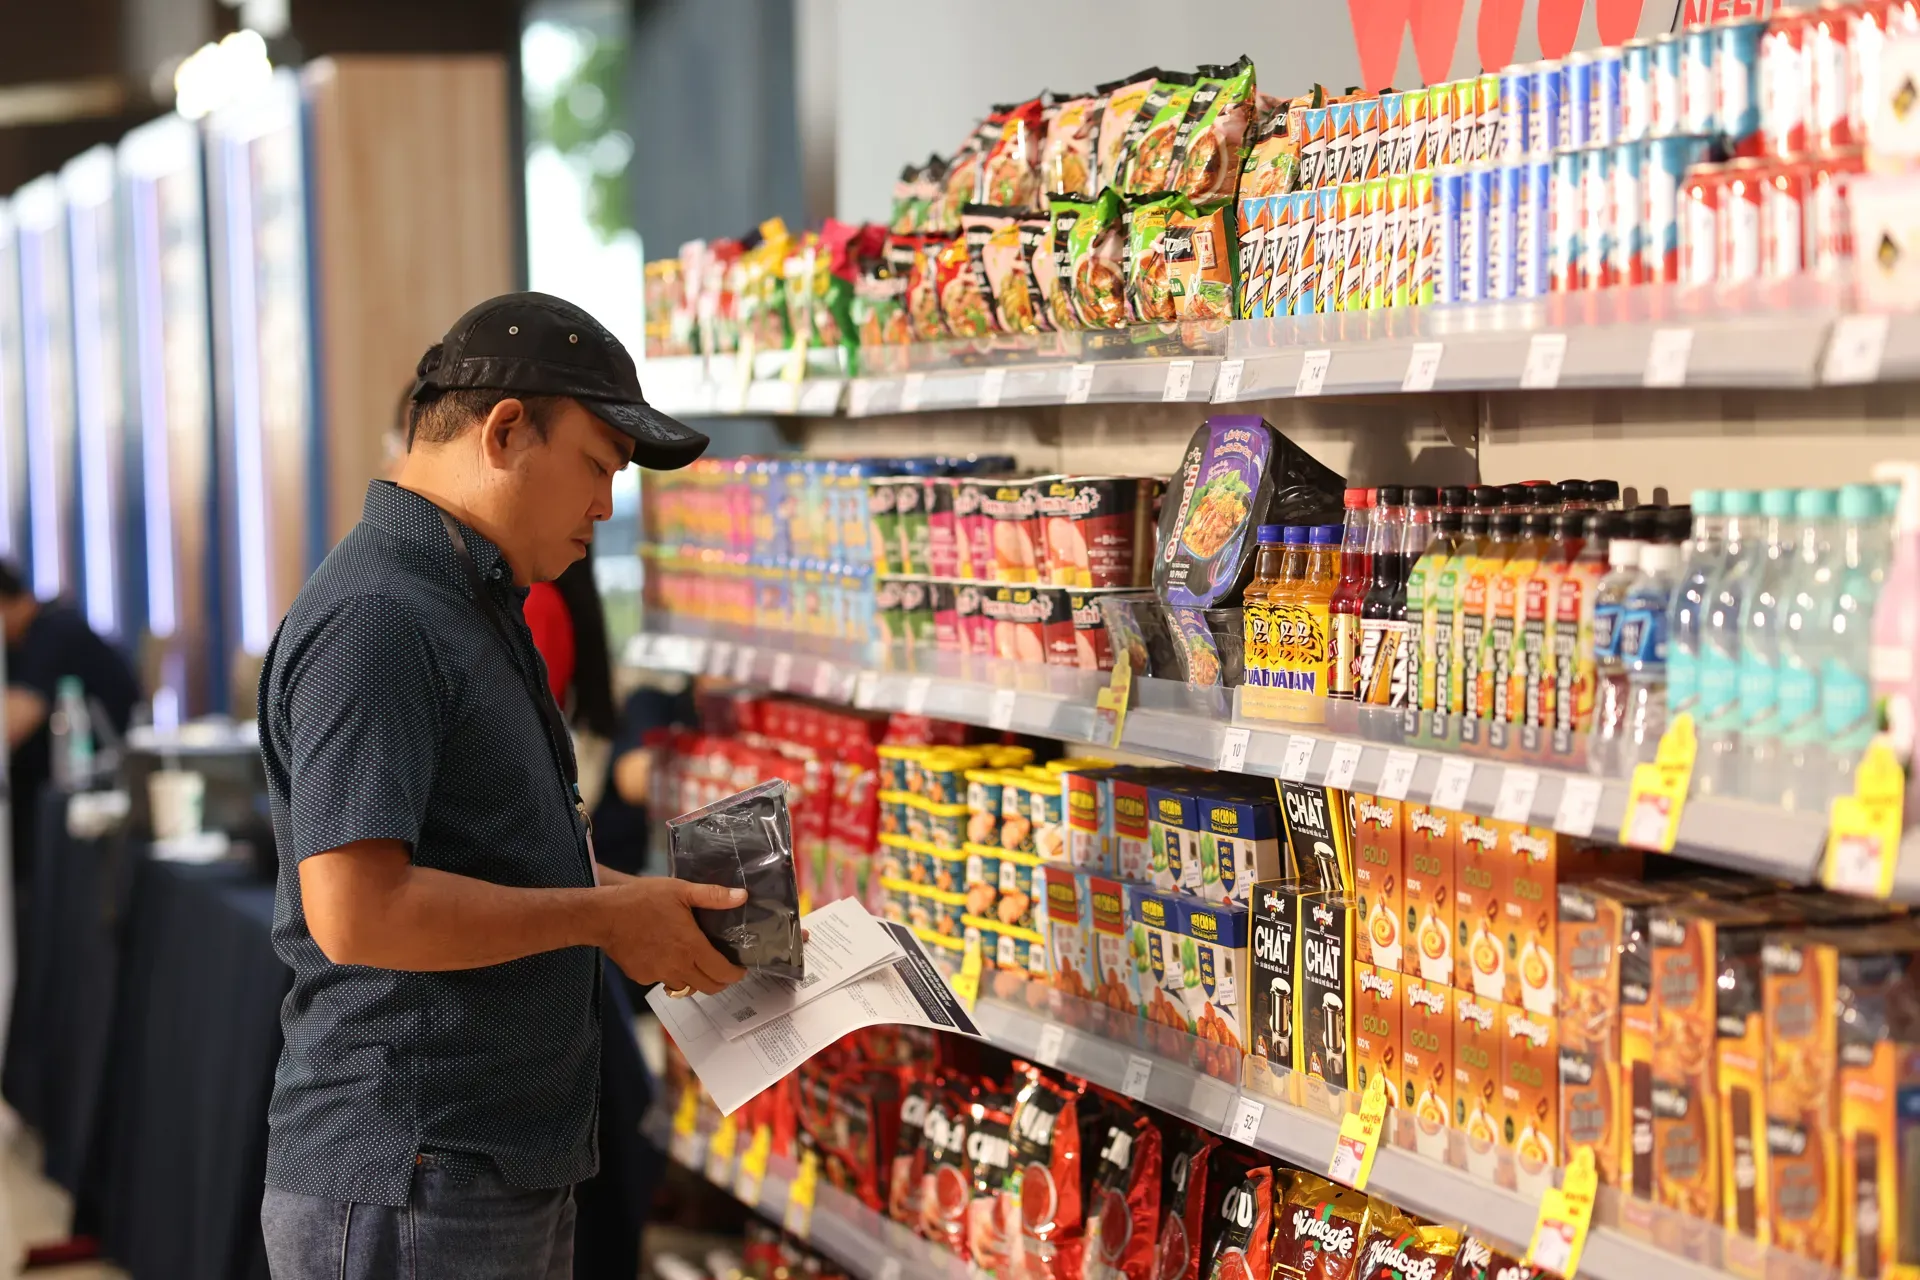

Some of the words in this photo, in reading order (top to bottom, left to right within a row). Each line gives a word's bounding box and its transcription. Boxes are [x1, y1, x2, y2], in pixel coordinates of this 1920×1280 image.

[1175, 569, 1188, 579] PHÚT
[1232, 743, 1241, 757] 10
[1299, 752, 1305, 766] 9
[1363, 845, 1389, 867] GOLD
[1414, 854, 1440, 877] GOLD
[1357, 868, 1370, 880] 100%
[1255, 925, 1291, 965] CHẤT
[1305, 938, 1341, 980] CHẤT
[1362, 1014, 1389, 1037] GOLD
[1411, 1028, 1439, 1053] GOLD
[1244, 1114, 1254, 1130] 52
[1292, 1209, 1354, 1257] Vinacafé
